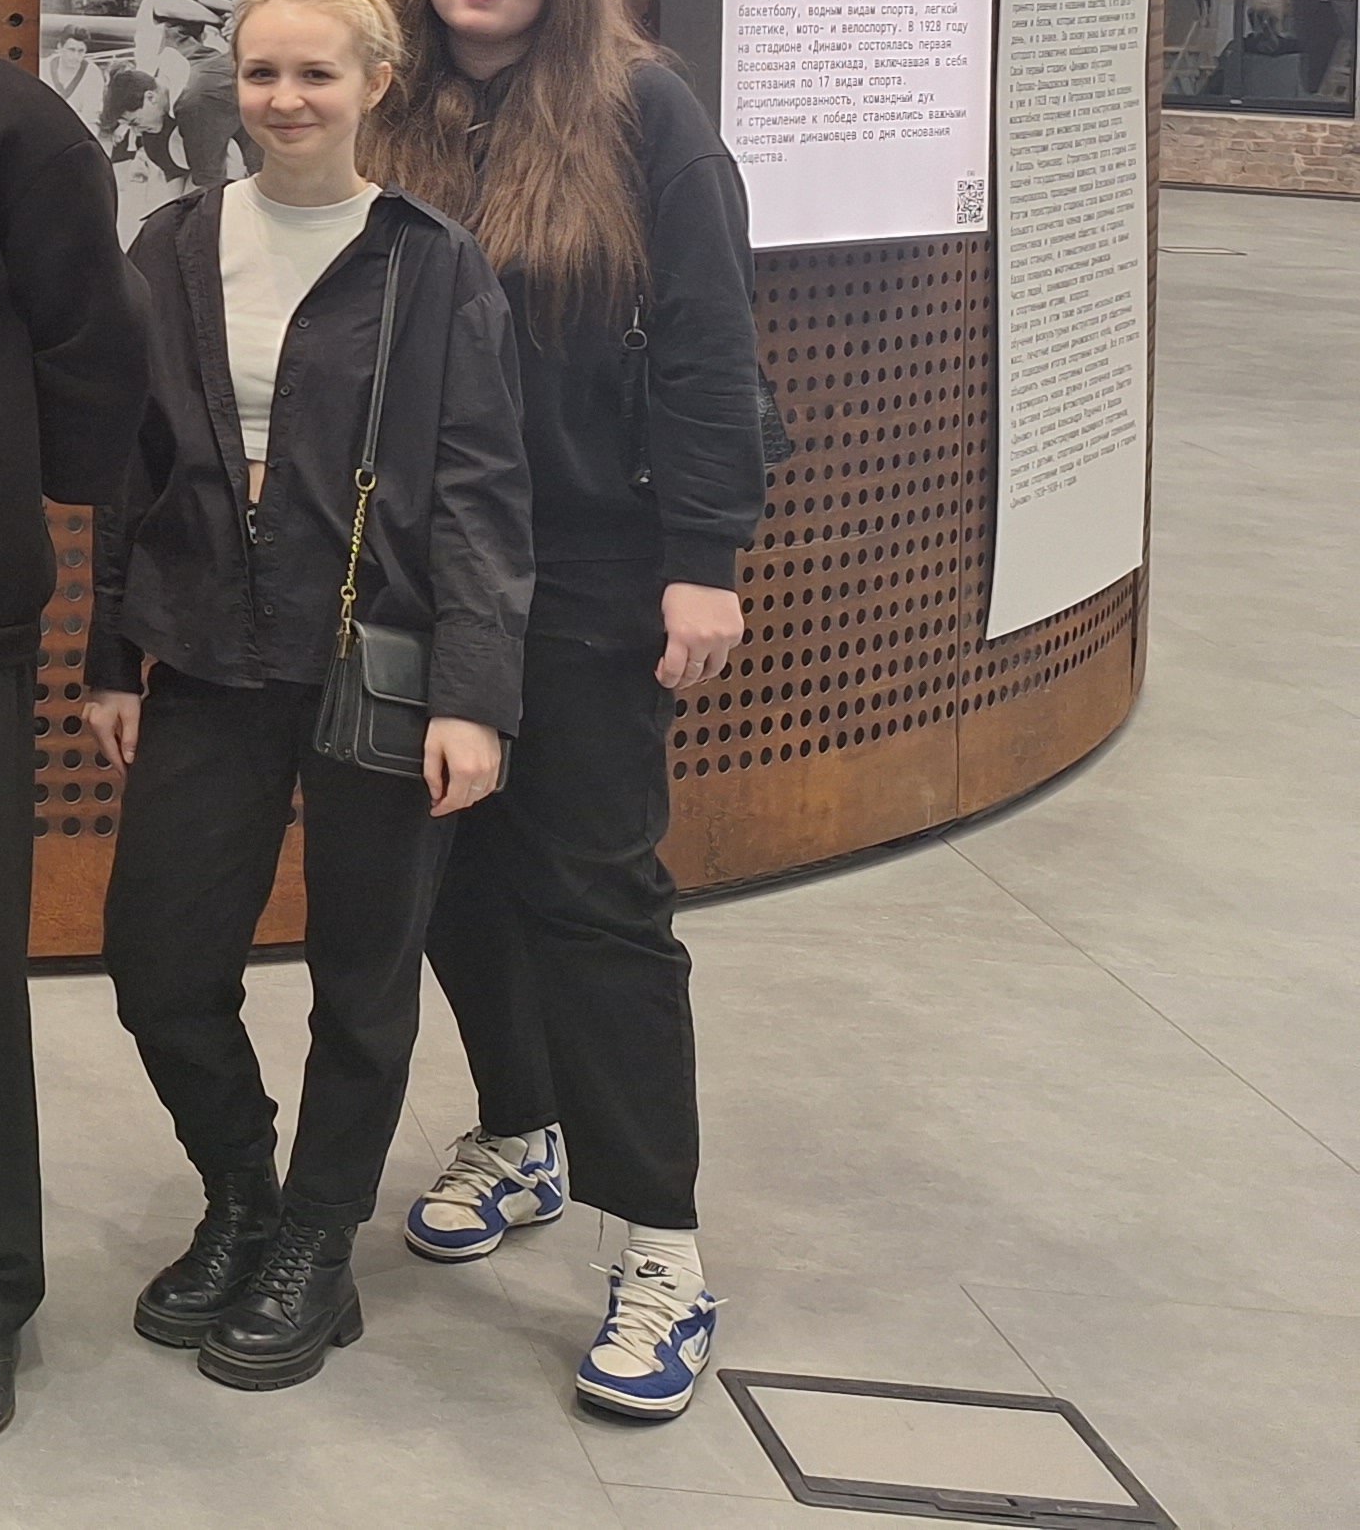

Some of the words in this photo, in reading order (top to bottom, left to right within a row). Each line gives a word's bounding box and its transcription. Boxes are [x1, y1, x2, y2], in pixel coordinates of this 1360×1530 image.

[739, 4, 800, 19] баскетболу,
[808, 7, 842, 17] водным
[848, 6, 875, 17] видам
[881, 6, 918, 17] спорта,
[925, 2, 957, 14] легкой
[738, 25, 788, 36] атлетике,
[797, 25, 824, 34] мото-
[831, 25, 836, 33] и
[842, 24, 902, 35] велоспорту.
[908, 21, 914, 32] В
[920, 20, 941, 32] 1928
[946, 23, 968, 34] году
[738, 44, 749, 53] на
[756, 43, 801, 55] стадионе
[808, 40, 852, 54] «Динамо»
[858, 41, 913, 51] состоялась
[919, 40, 951, 52] первая
[738, 60, 795, 72] Всесоюзная
[802, 60, 867, 72] спартакиада,
[875, 58, 929, 68] включавшая
[935, 58, 940, 66] в
[946, 54, 967, 66] себя
[737, 80, 795, 90] состязания
[801, 79, 812, 88] по
[819, 76, 829, 88] 17
[835, 78, 863, 89] видам
[869, 76, 906, 88] спорта.
[736, 96, 855, 110] Дисциплинированность,
[863, 91, 912, 105] командный
[918, 93, 934, 104] дух
[737, 118, 742, 126] и
[749, 115, 806, 129] стремление
[812, 115, 817, 124] к
[824, 111, 857, 124] победе
[863, 111, 923, 122] становились
[929, 110, 966, 119] важными
[736, 134, 794, 145] качествами
[800, 131, 857, 144] динамовцев
[863, 131, 873, 139] со
[879, 130, 895, 141] дня
[901, 127, 950, 138] основания
[737, 153, 787, 165] общества.
